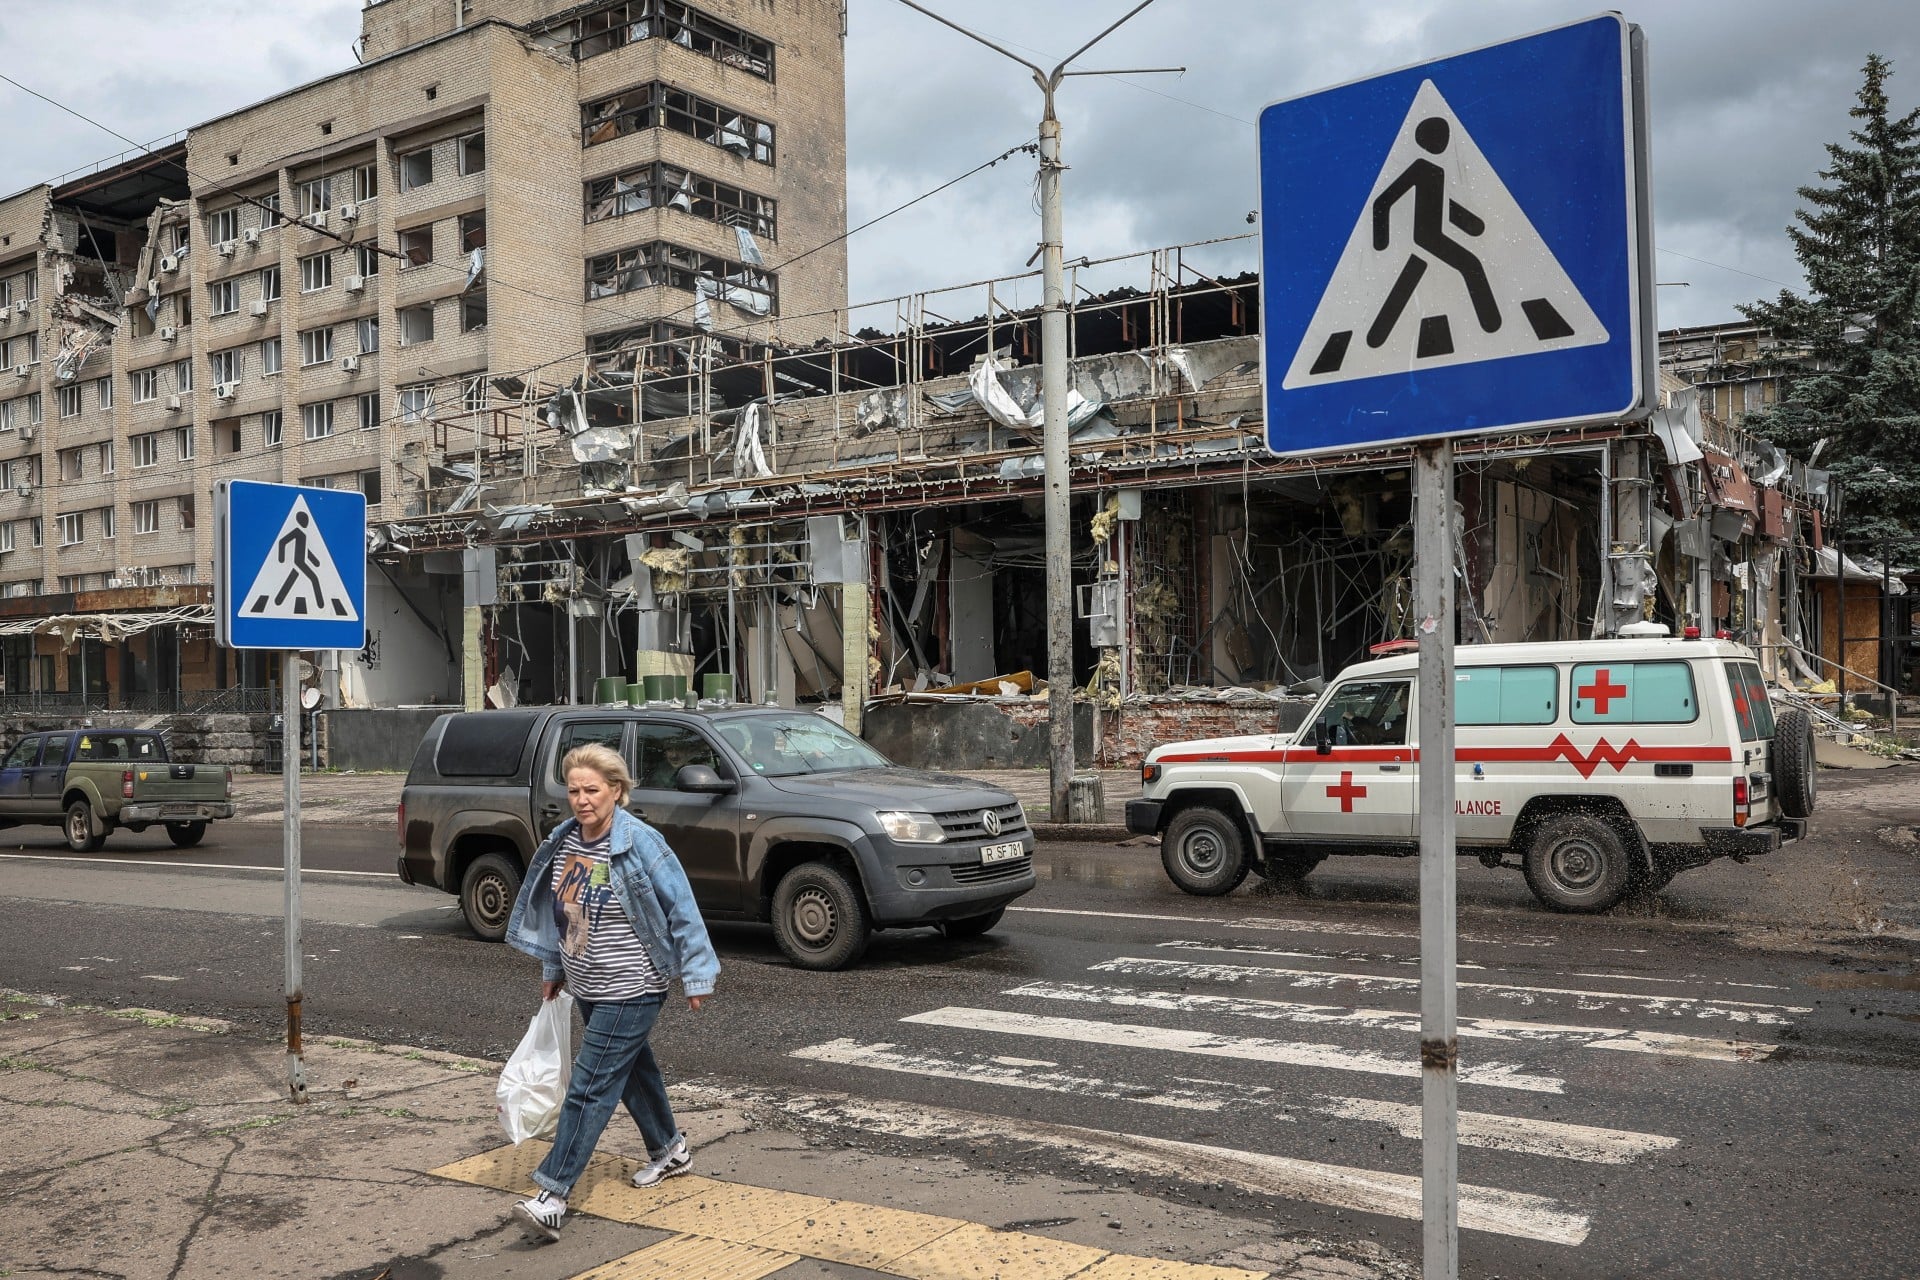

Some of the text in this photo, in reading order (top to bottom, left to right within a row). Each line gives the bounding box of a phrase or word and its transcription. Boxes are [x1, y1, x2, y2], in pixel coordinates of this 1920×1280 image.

[986, 842, 1022, 860] R SF 781
